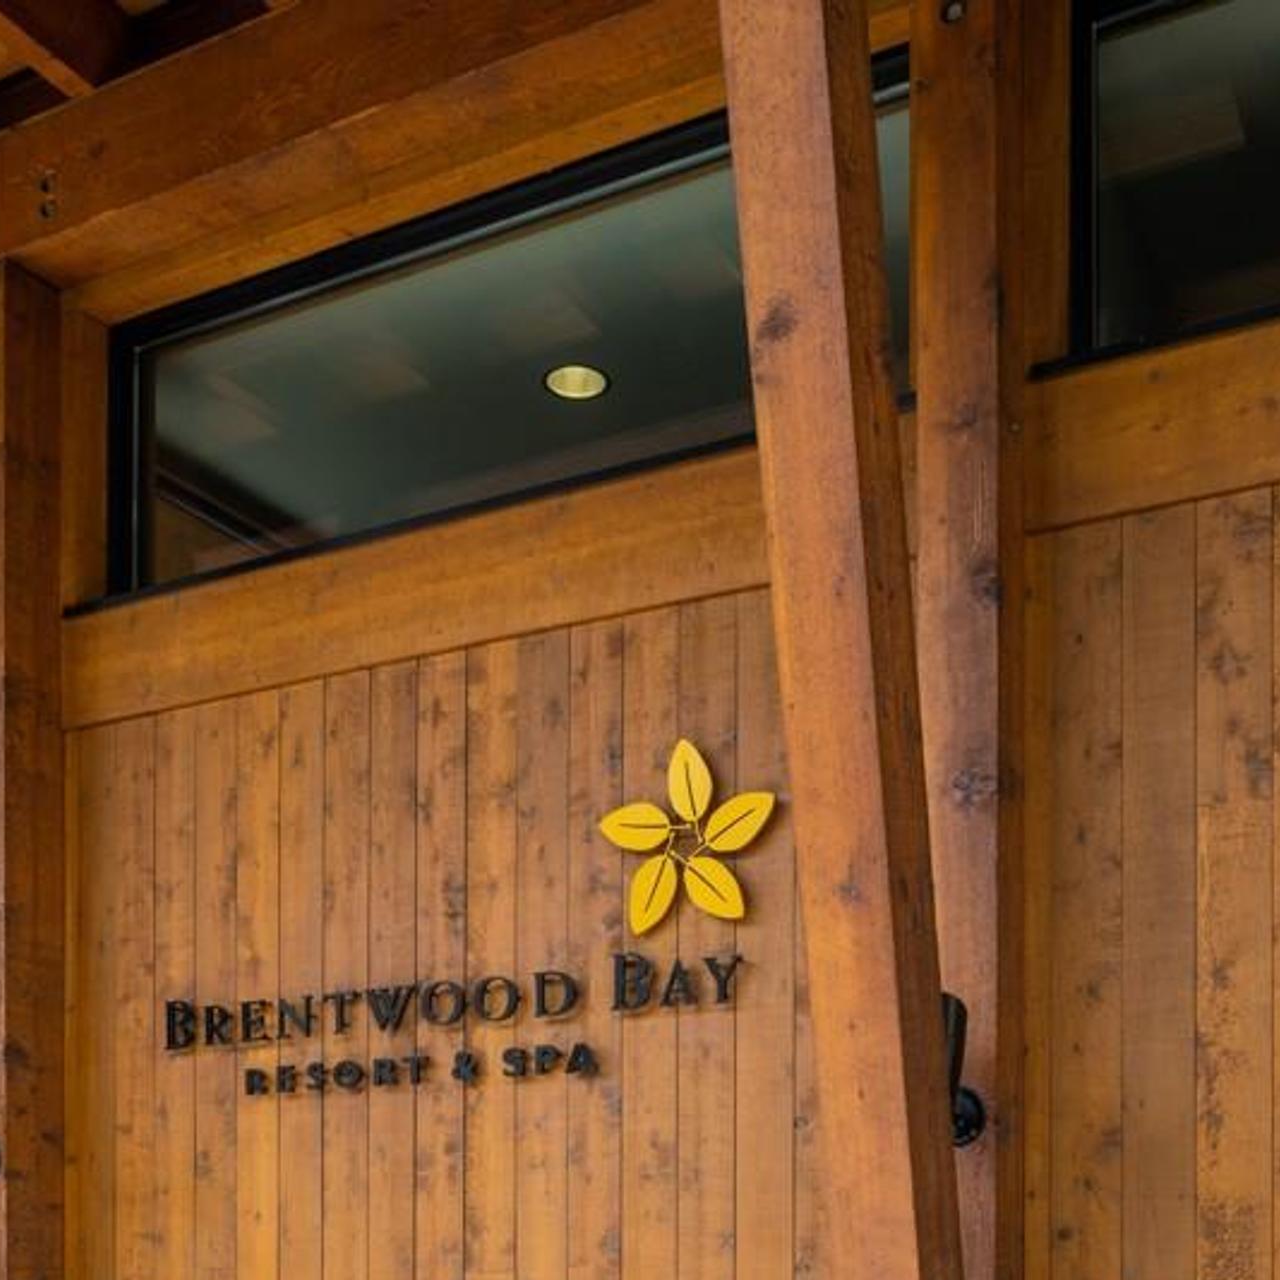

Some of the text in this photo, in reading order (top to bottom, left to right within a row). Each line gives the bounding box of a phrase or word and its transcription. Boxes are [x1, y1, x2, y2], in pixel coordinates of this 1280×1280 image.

[164, 952, 744, 1050] BRENTWOOD BAY
[244, 1042, 600, 1096] RESORT & SPA
